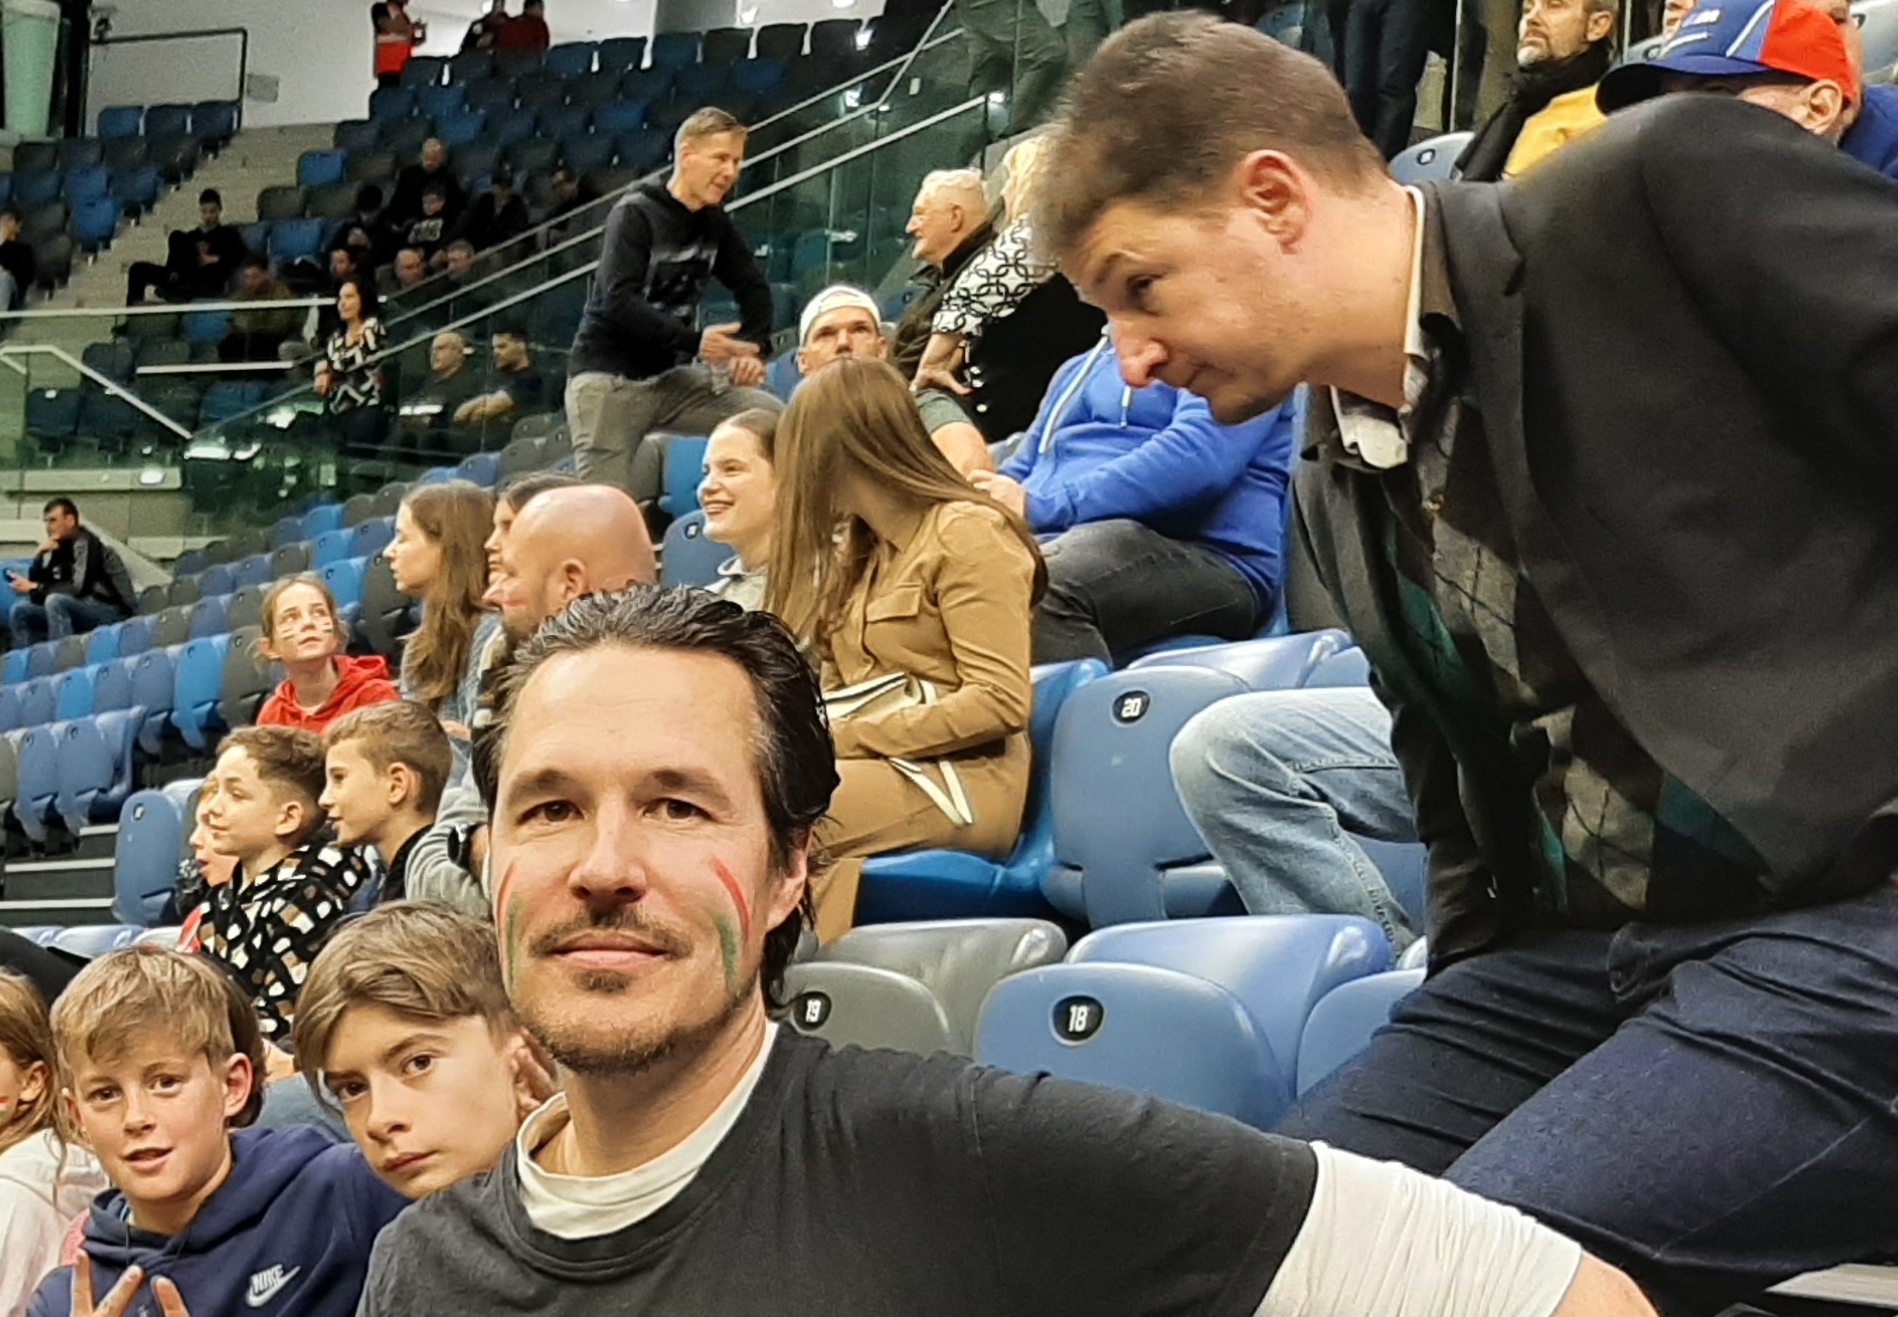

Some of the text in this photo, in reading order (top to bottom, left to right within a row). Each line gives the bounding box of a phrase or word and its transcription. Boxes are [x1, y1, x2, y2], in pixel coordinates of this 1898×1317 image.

[1121, 697, 1142, 718] 20
[806, 999, 822, 1023] 19
[1068, 1004, 1088, 1032] 18
[250, 1263, 284, 1294] NIKE
